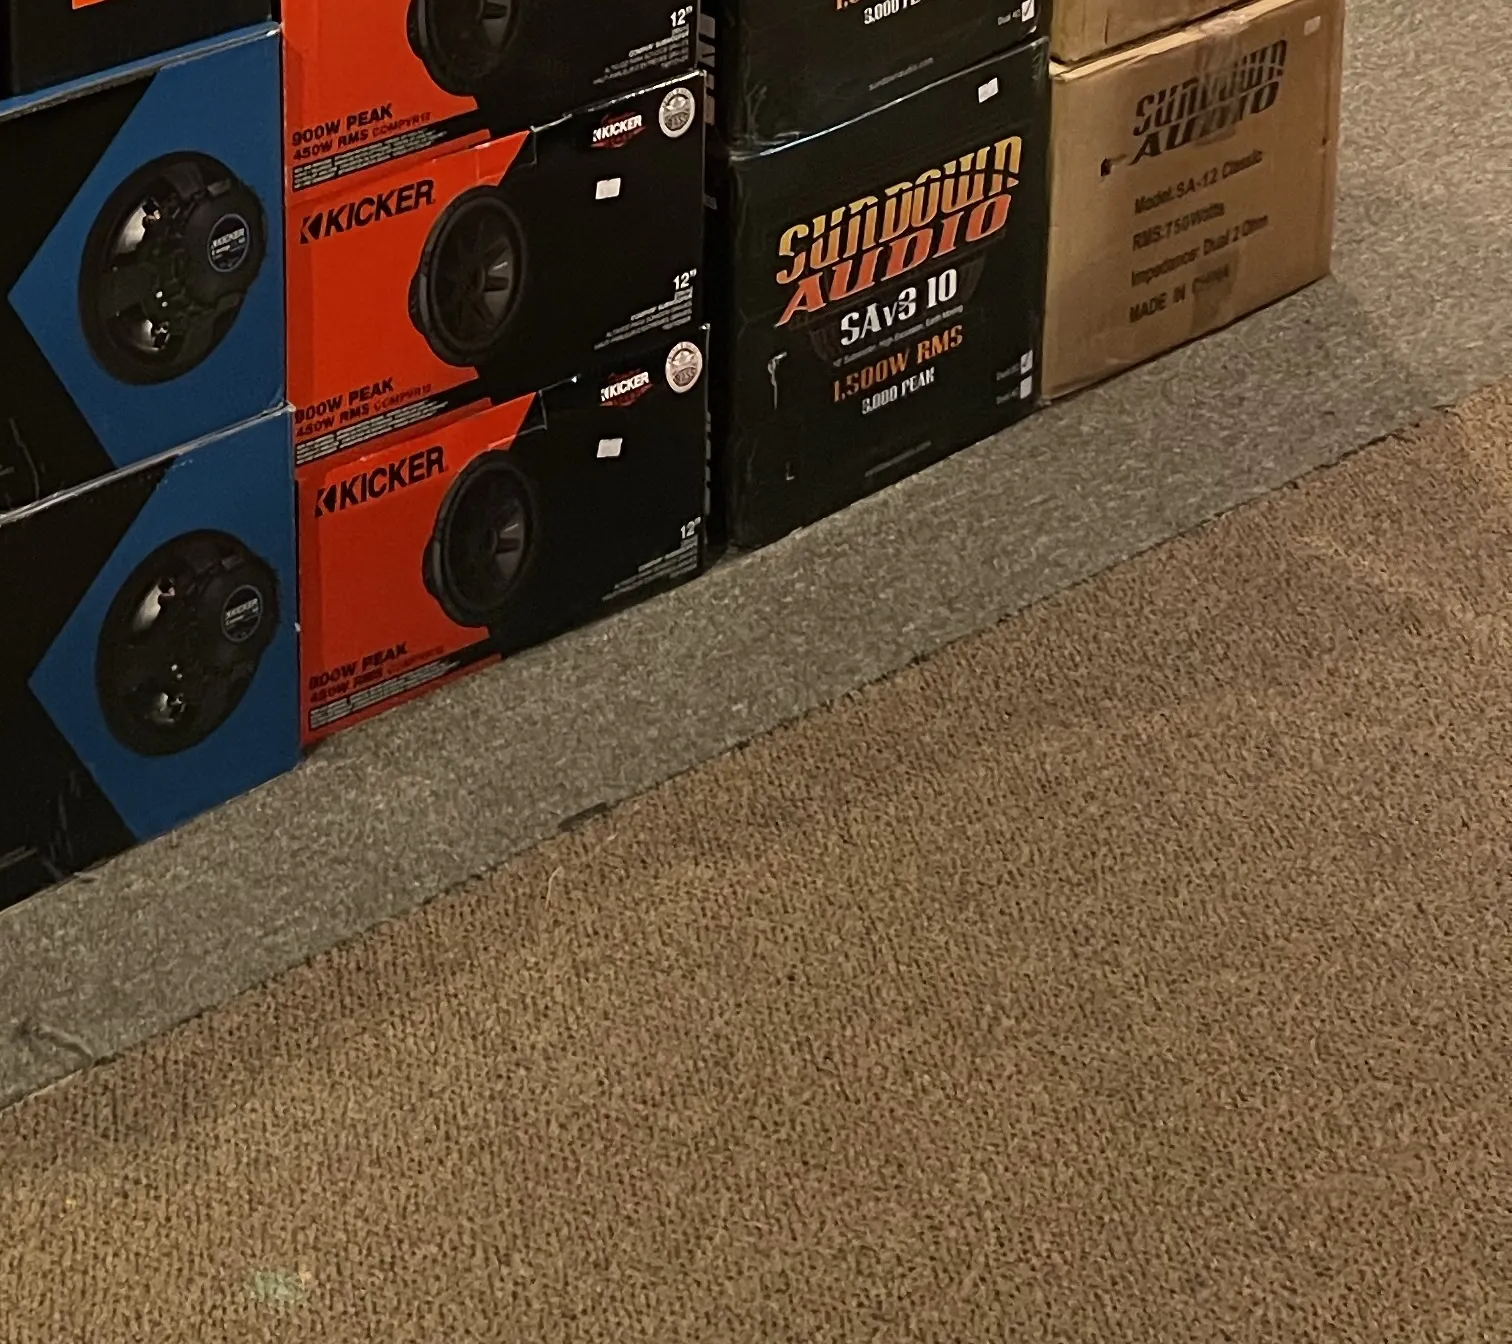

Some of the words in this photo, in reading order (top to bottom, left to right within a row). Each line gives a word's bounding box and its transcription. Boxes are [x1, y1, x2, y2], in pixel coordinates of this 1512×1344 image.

[669, 5, 694, 27] 12"
[291, 120, 341, 147] 900W
[345, 103, 393, 128] PEAK
[601, 114, 643, 142] KICKER
[292, 136, 335, 161] 450W
[337, 129, 368, 147] RMS
[324, 179, 434, 238] KICKER
[775, 134, 1023, 285] SUNDOWN
[673, 268, 697, 291] 12"
[773, 193, 1013, 328] AUDIO
[926, 268, 958, 308] 10
[916, 324, 964, 362] RMS
[347, 377, 394, 402] PEAK
[607, 371, 650, 400] KICKER
[339, 446, 445, 512] KICKER
